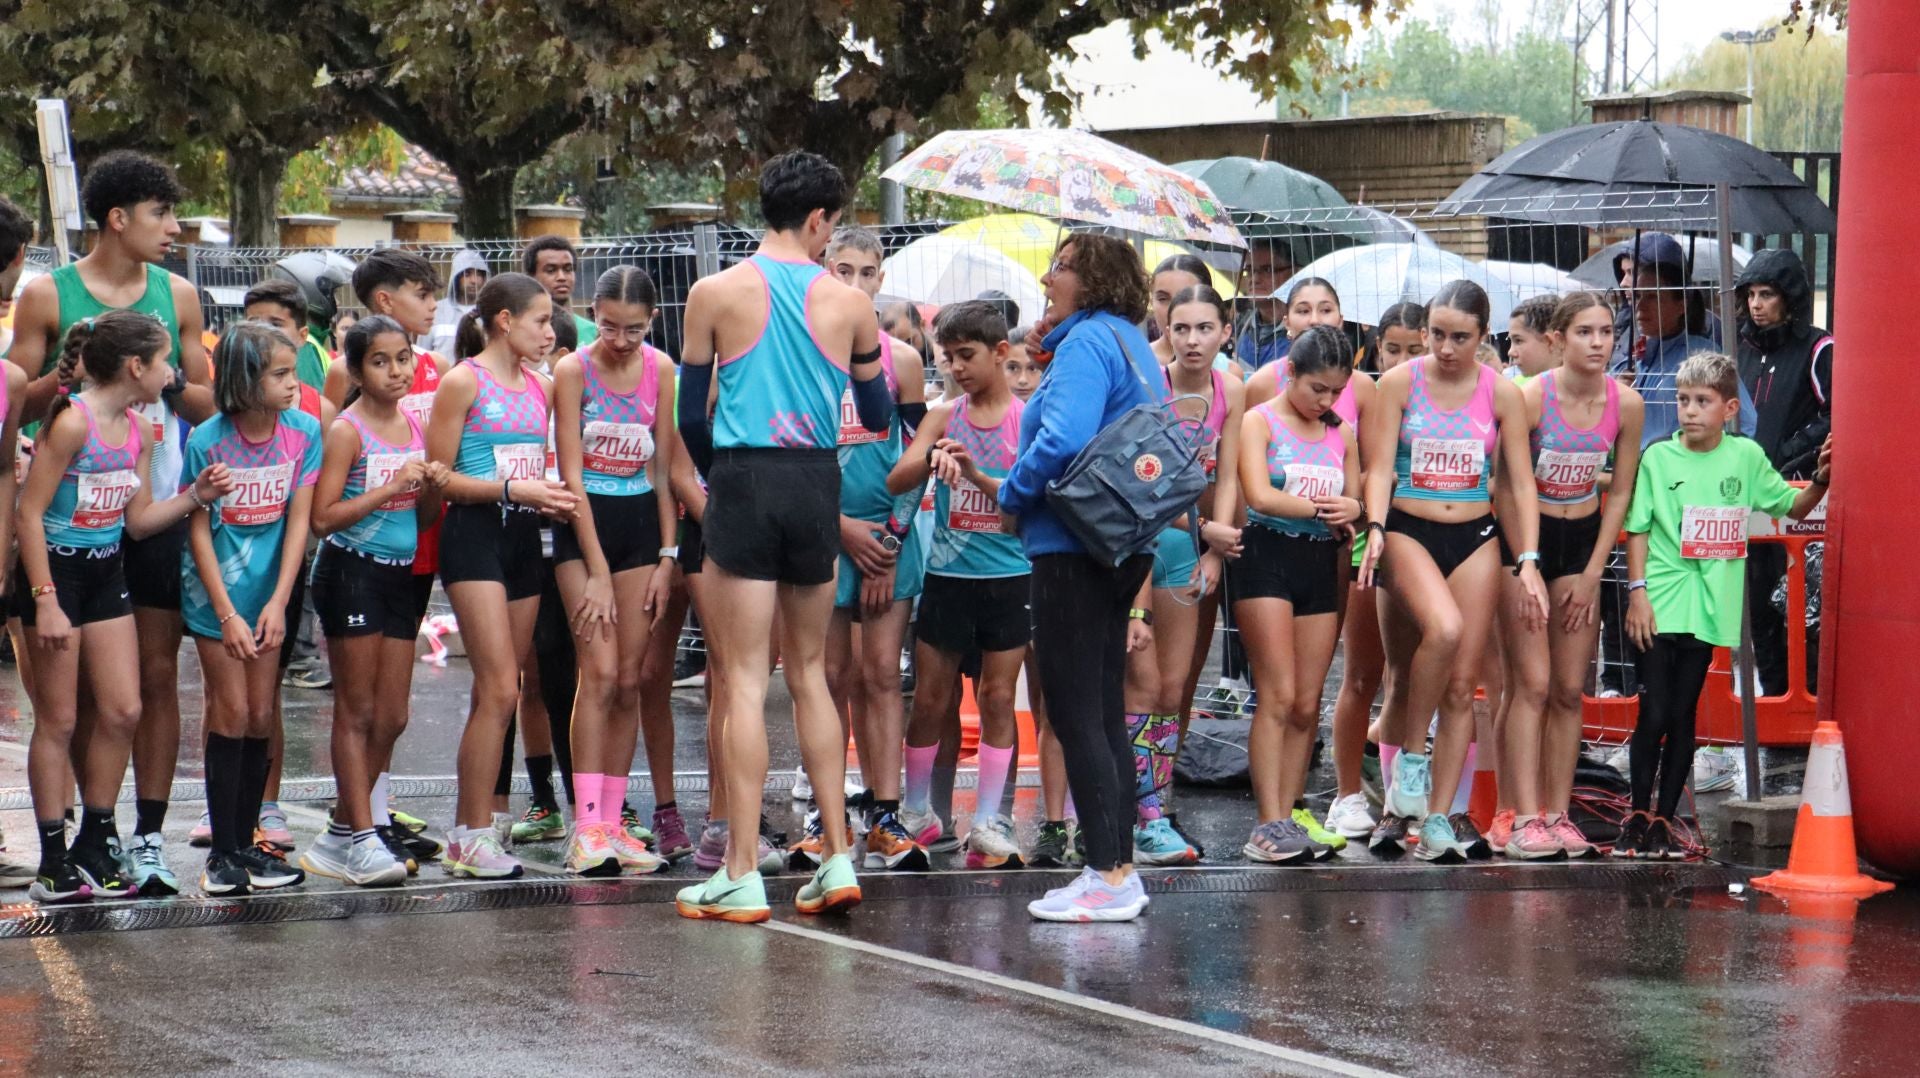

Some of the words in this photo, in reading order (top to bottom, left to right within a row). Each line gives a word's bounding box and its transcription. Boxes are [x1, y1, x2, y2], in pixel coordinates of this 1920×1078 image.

[593, 435, 643, 459] 2044
[1423, 451, 1473, 474] 2048
[1546, 463, 1596, 484] 2039
[235, 479, 285, 506] 2045
[1297, 476, 1333, 499] 2041
[1694, 519, 1740, 541] 2008
